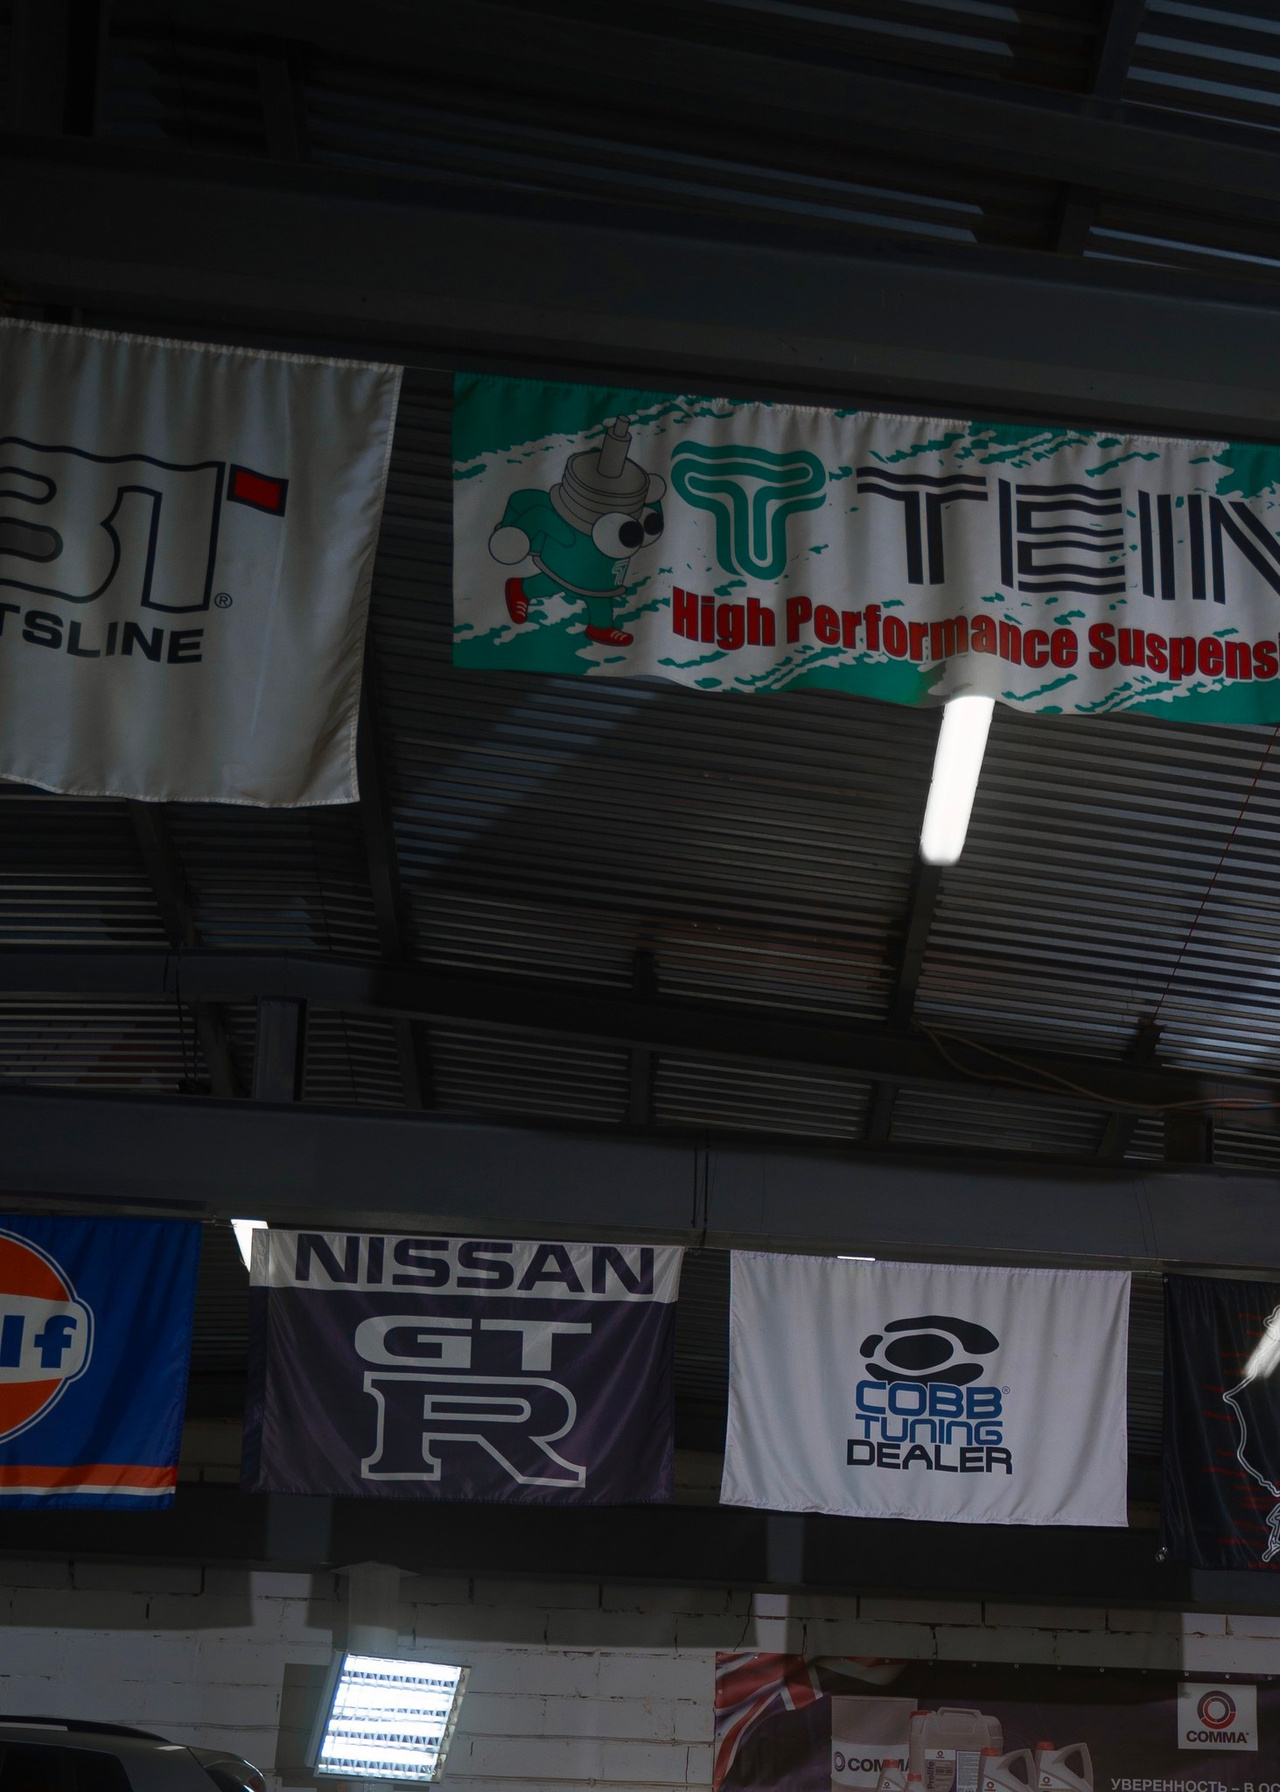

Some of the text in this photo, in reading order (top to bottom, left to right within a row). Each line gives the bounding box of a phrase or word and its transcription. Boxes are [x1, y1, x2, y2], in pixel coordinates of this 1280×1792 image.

[672, 586, 776, 651] High
[786, 596, 1078, 668] Performance
[295, 1233, 655, 1296] NISSAN
[354, 1314, 592, 1372] GT
[855, 1379, 1003, 1420] COBB
[360, 1370, 588, 1488] R
[855, 1413, 1003, 1447] TUNING
[846, 1438, 1013, 1475] DEALER
[1186, 1730, 1248, 1744] COMMA
[926, 1761, 935, 1790] Prolife
